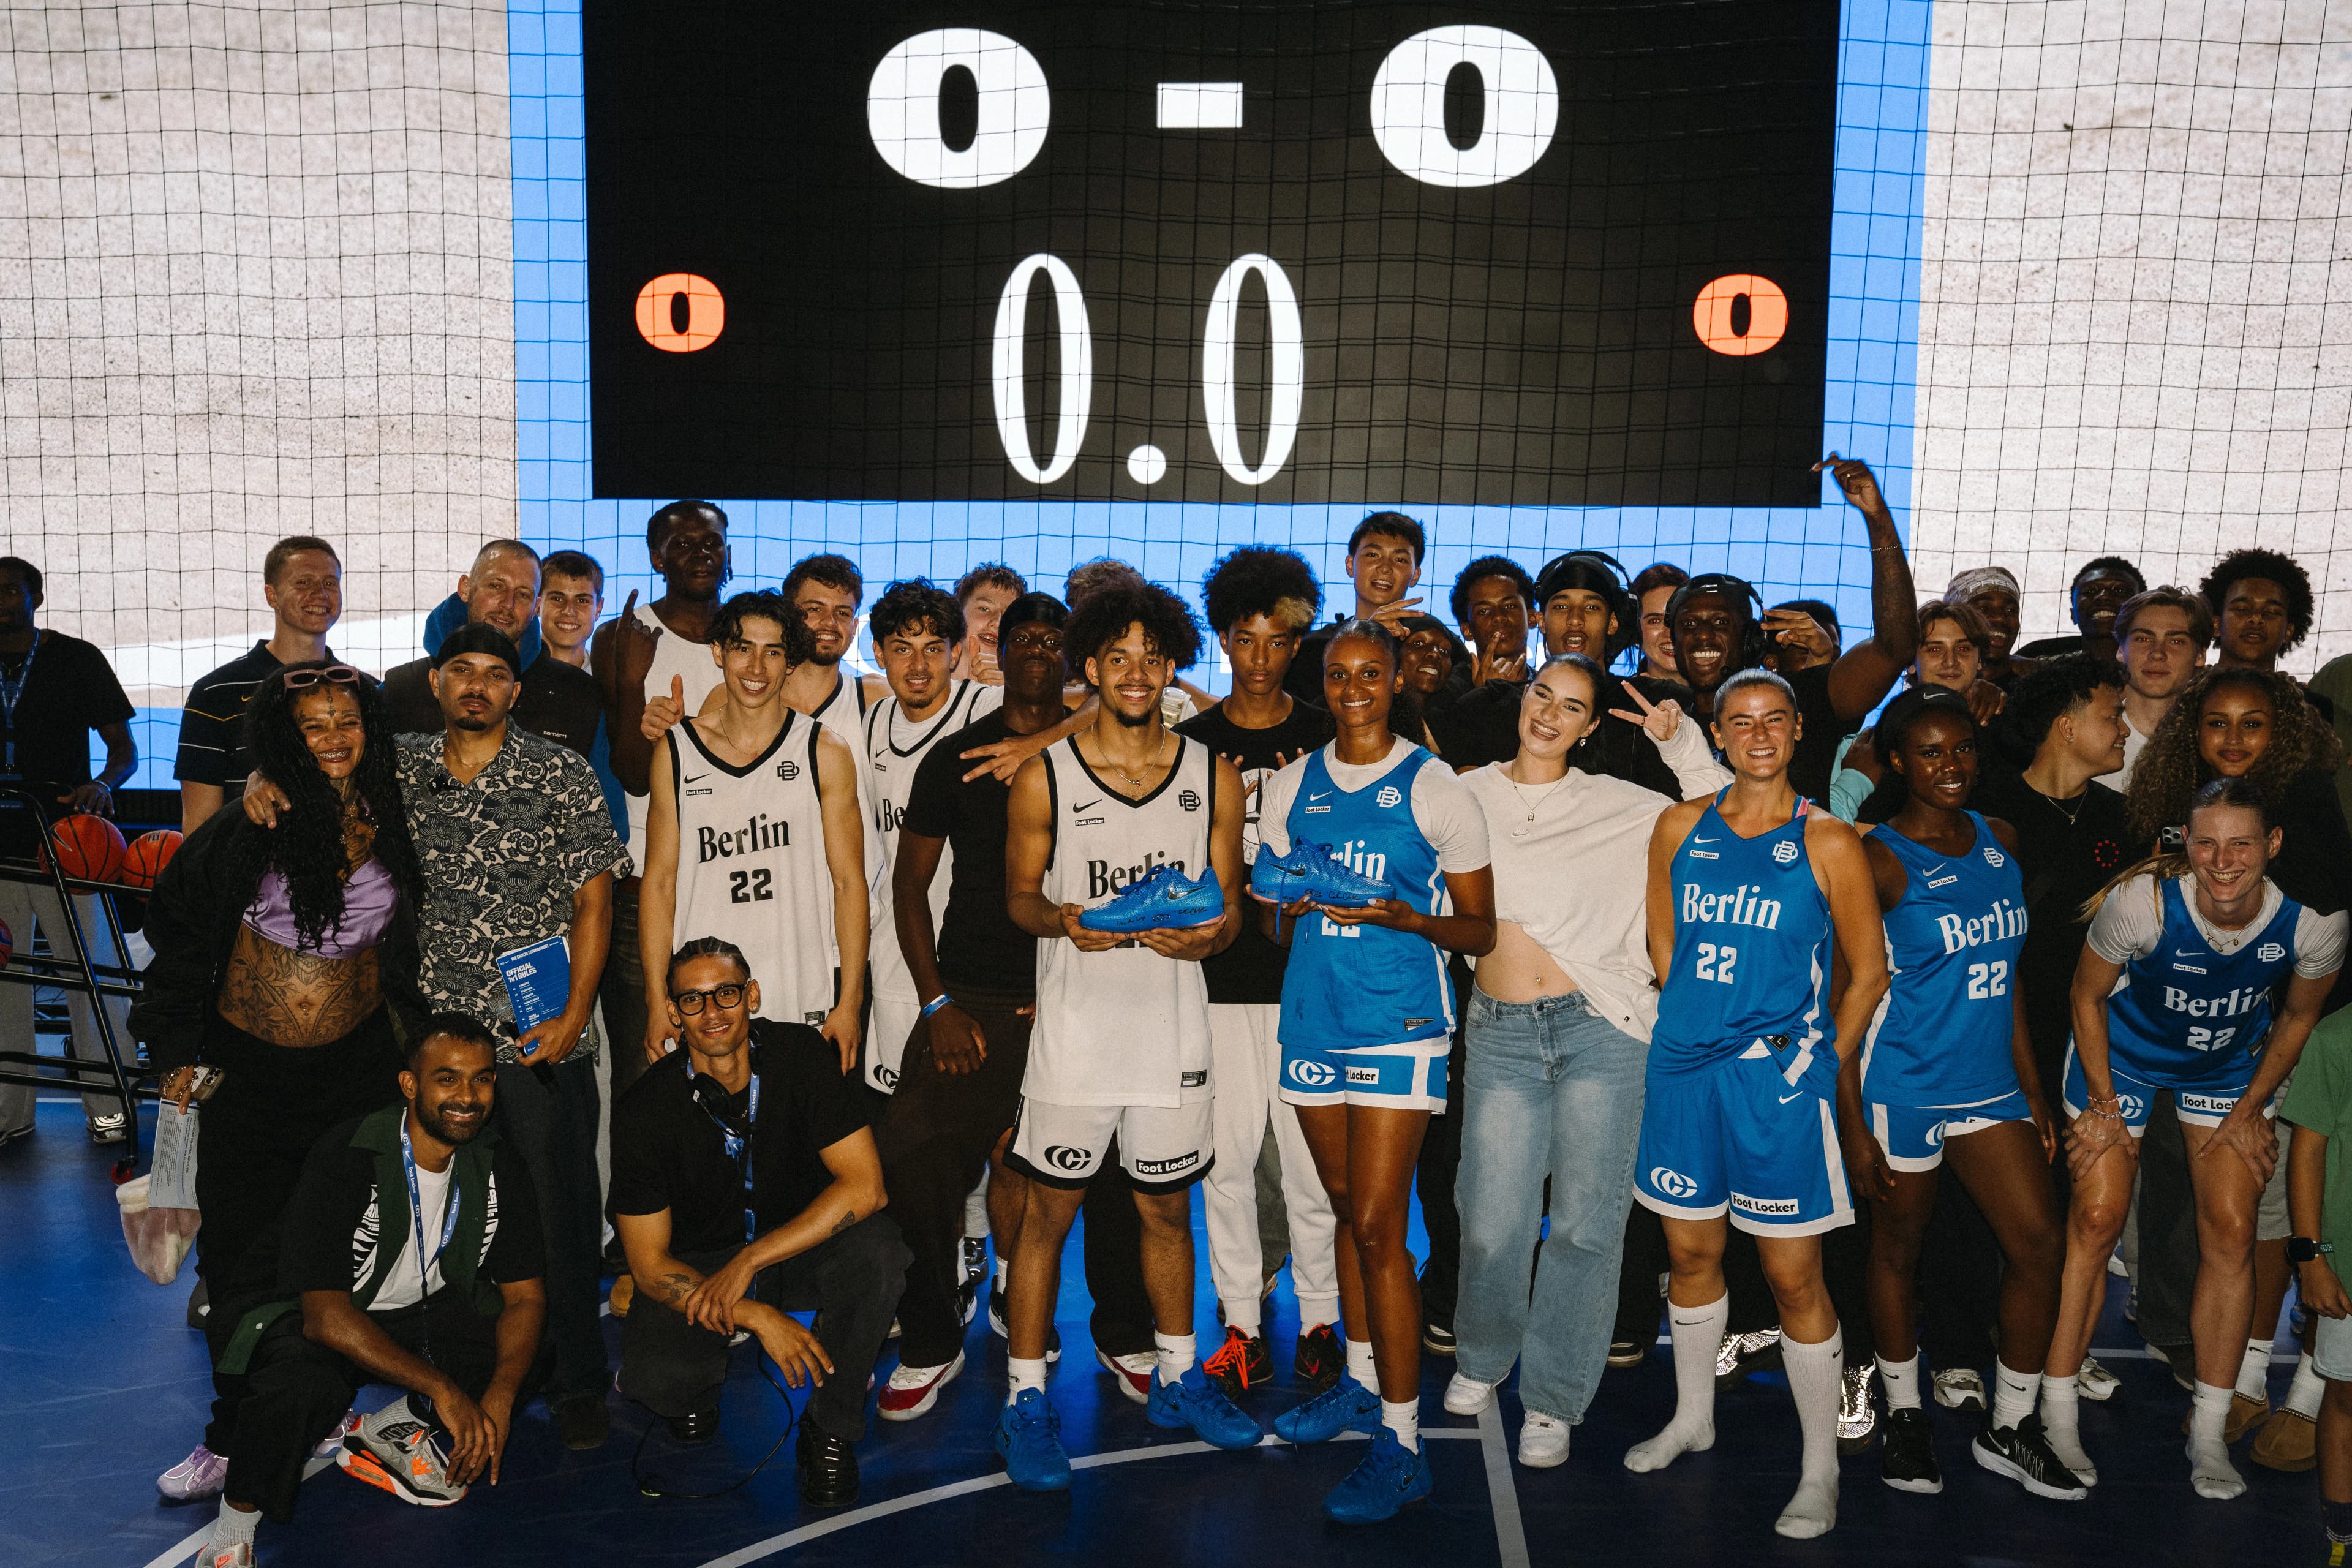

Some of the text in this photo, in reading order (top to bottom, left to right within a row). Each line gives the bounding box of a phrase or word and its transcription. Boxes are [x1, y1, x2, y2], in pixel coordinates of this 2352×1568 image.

[867, 27, 1050, 189] 0
[1370, 24, 1559, 188] 0
[635, 273, 726, 353] 0
[1692, 273, 1789, 356] 0
[992, 252, 1305, 486] 0.0
[696, 813, 791, 864] Berlin
[1330, 840, 1386, 881] rlin
[729, 868, 774, 903] 22
[1682, 883, 1781, 930] Berlin
[1935, 898, 2028, 956] Berlin
[506, 962, 533, 976] OFFICIAL
[508, 967, 537, 983] 1v1 RULES
[1696, 942, 1738, 985] 22
[1968, 960, 2008, 1000] 22
[2187, 1026, 2236, 1052] 22
[1349, 1069, 1376, 1082] Locker
[2184, 1096, 2236, 1111] Foot Loc
[1138, 1153, 1197, 1174] Foot Locker
[1733, 1194, 1795, 1213] Foot Locker
